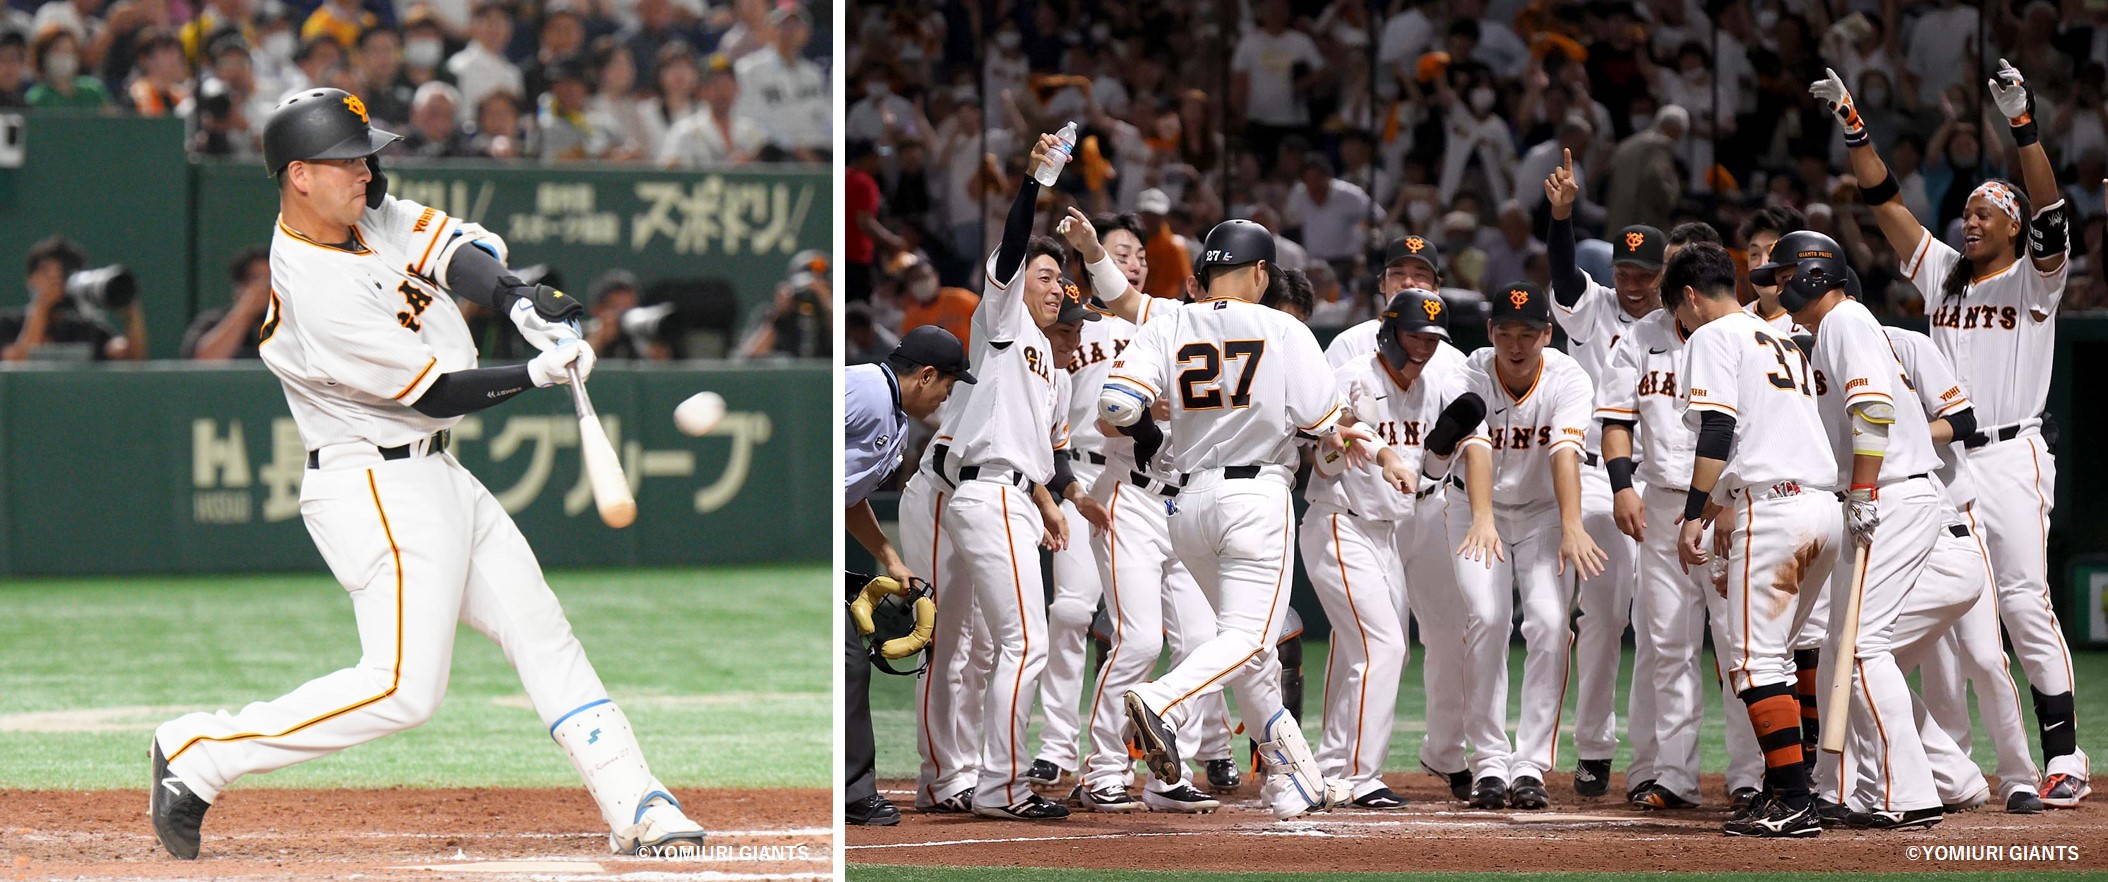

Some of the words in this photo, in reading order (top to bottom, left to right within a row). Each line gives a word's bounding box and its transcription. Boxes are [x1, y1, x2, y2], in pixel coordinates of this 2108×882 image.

[1206, 250, 1221, 262] 27
[1176, 339, 1265, 410] 27
[1754, 331, 1812, 399] 37
